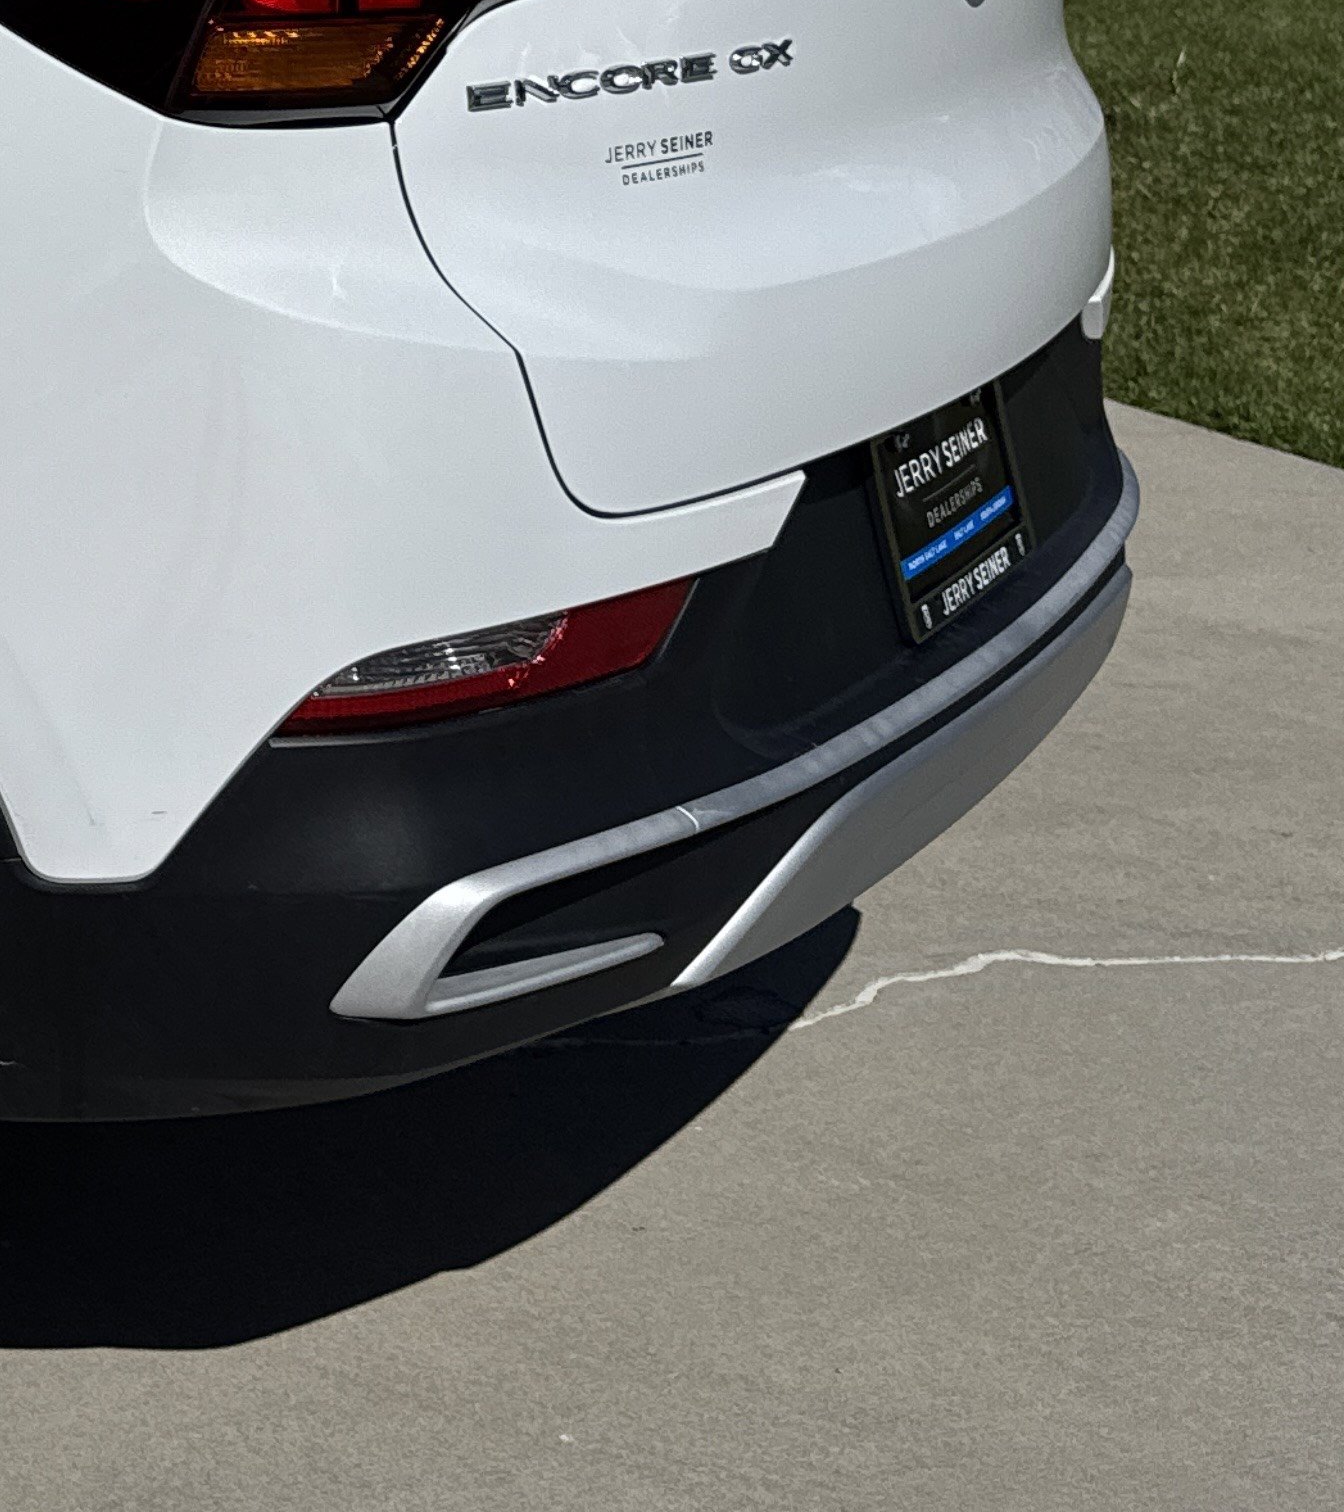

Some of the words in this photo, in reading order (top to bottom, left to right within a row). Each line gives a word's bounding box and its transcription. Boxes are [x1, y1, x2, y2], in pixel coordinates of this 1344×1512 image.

[466, 51, 718, 112] ENCORE
[729, 38, 794, 74] GX
[605, 140, 657, 164] JERRY
[660, 130, 714, 155] SEINER
[622, 160, 705, 186] DEALERSHIPS
[893, 445, 943, 498] JERRY
[941, 417, 988, 468] SEINER
[926, 476, 983, 528] DEALERSHIPS
[941, 571, 976, 616] JERRY
[972, 546, 1011, 590] SEINER
